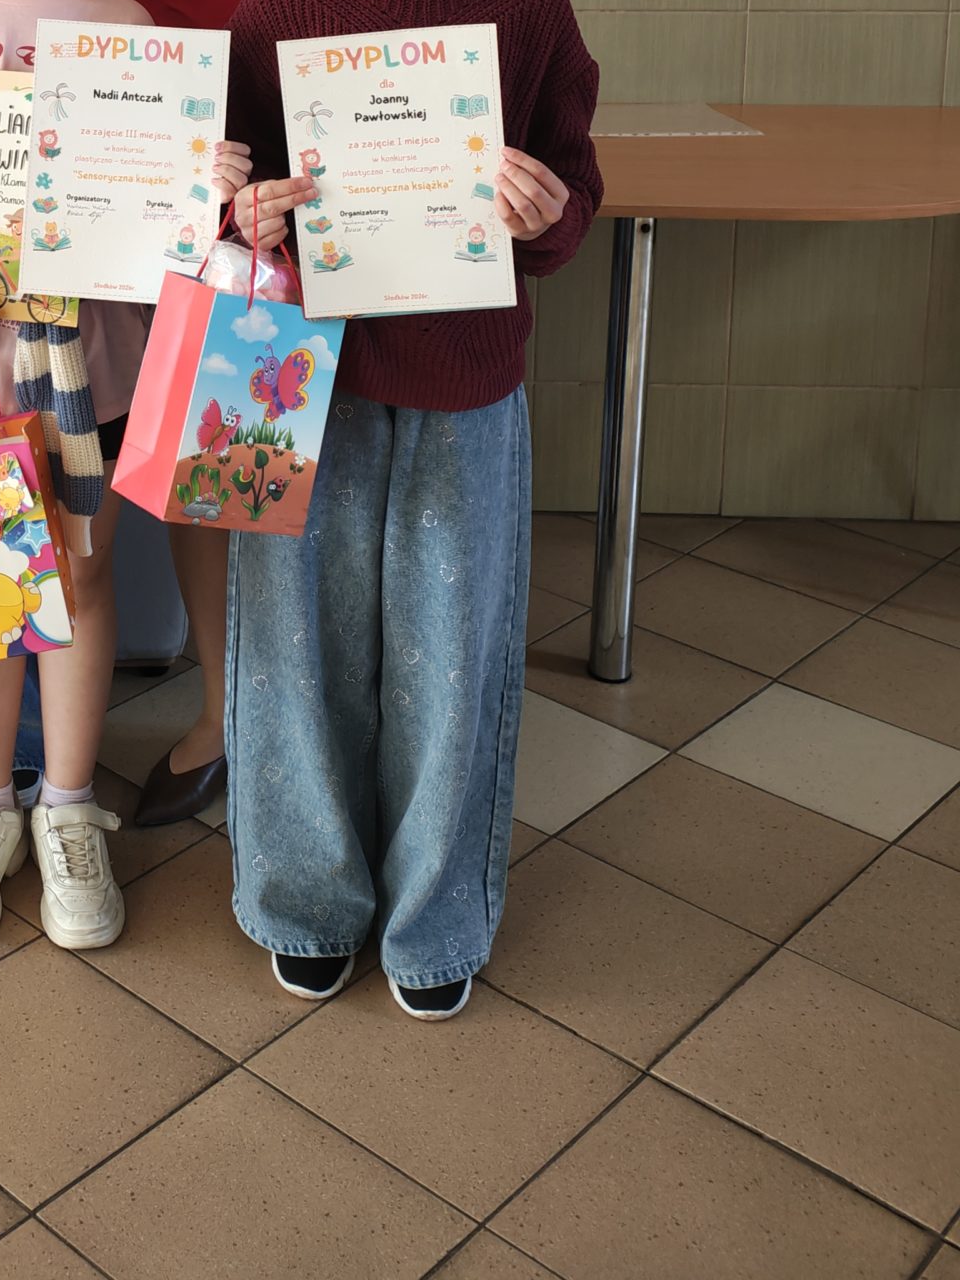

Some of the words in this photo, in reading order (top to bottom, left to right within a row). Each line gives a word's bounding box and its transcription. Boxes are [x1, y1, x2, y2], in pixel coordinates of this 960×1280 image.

[77, 34, 183, 64] DYPLOM
[325, 40, 446, 73] DYPLOM
[121, 71, 135, 81] dla
[379, 79, 395, 89] dla
[93, 89, 119, 101] Nadii
[121, 91, 164, 104] Antczak
[369, 94, 409, 106] Joanny
[354, 108, 427, 123] Pawłowskiej
[93, 128, 123, 138] zajęcie
[125, 129, 137, 138] III
[139, 131, 172, 141] miejsca
[111, 145, 145, 153] konkursie
[362, 139, 395, 149] zajęcie
[404, 136, 440, 146] miejsca
[74, 155, 113, 165] plastyczno
[120, 158, 162, 168] technicznym
[380, 154, 417, 162] konkursie
[342, 169, 384, 178] plastyczno
[392, 165, 439, 174] technicznym
[66, 193, 111, 204] Organizatorzy
[146, 200, 173, 209] Dyrekcja
[339, 209, 389, 218] Organizatorzy
[427, 205, 457, 213] Dyrekcja
